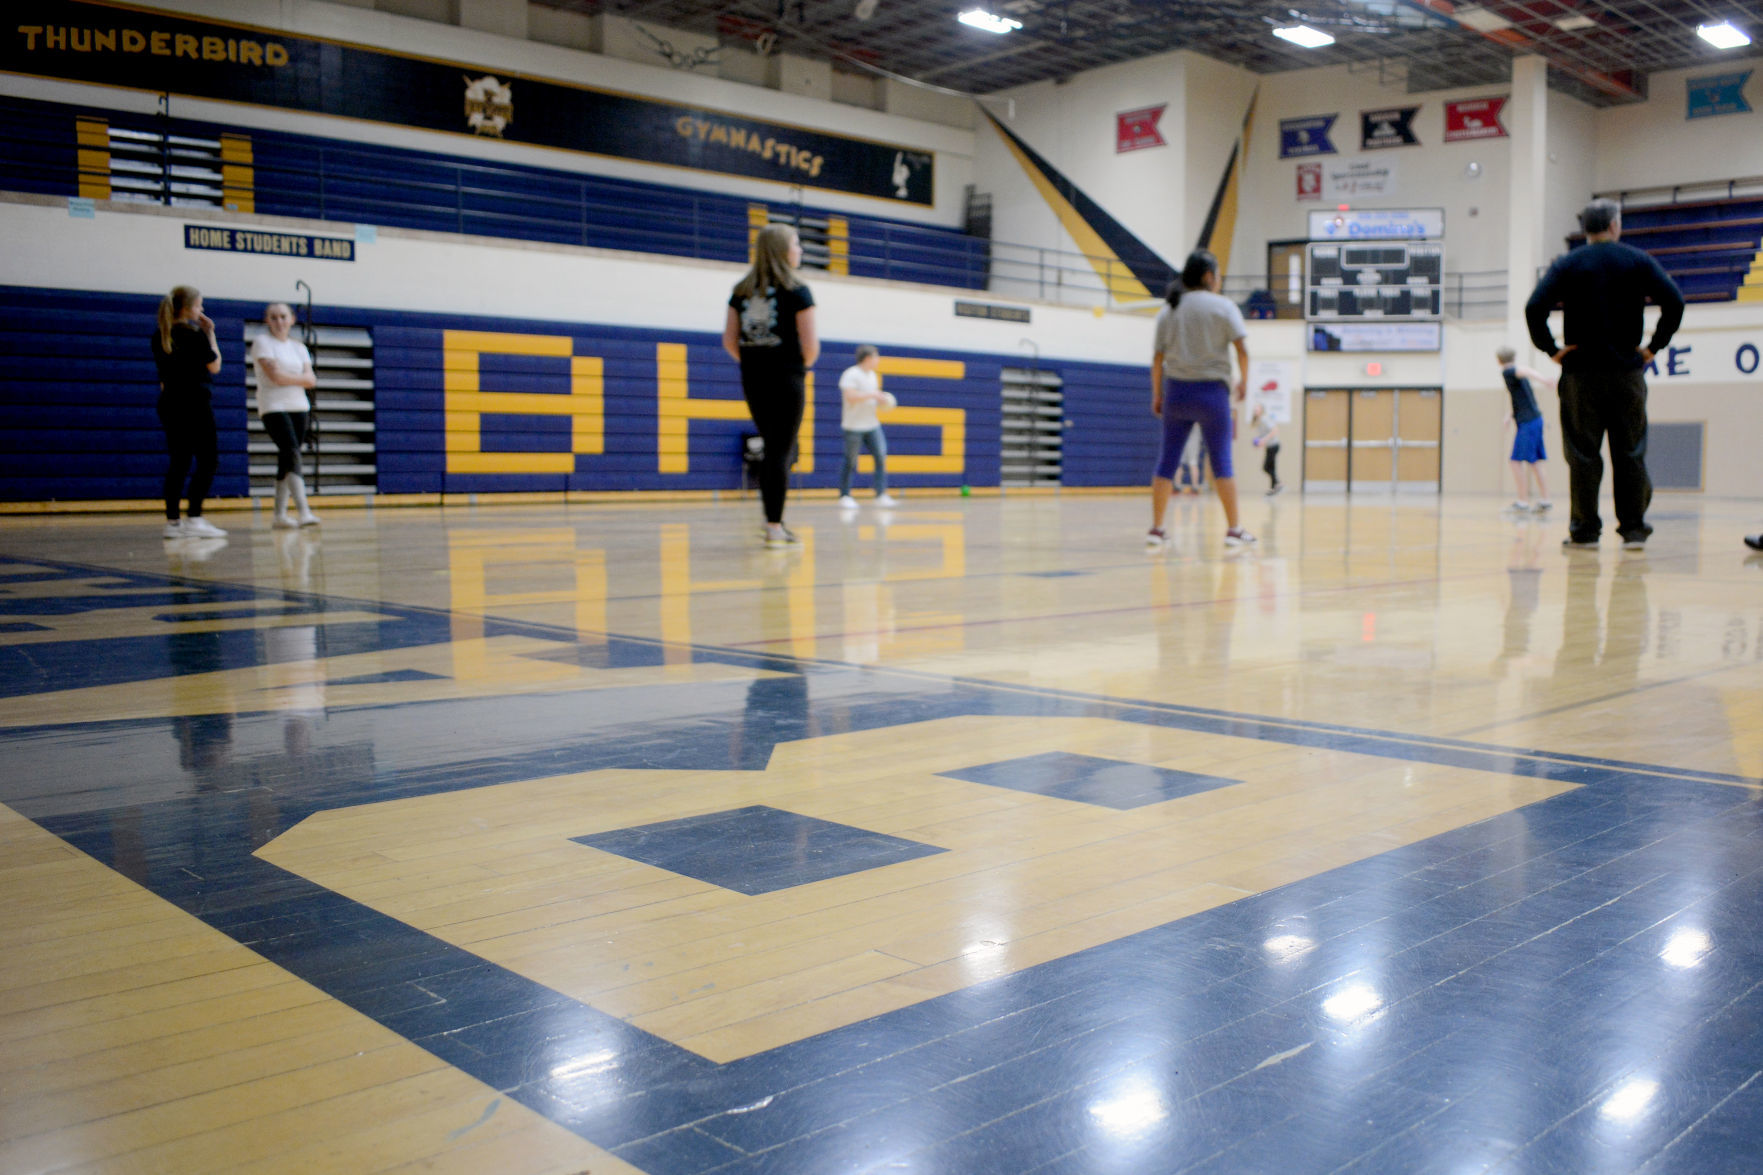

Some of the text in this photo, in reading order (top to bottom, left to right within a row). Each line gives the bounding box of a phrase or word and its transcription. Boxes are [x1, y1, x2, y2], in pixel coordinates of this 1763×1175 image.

[18, 25, 825, 177] THUNDERBIRD GYMNASTICS
[189, 227, 351, 259] HOME STUDENTS BAND
[443, 329, 966, 474] BHS
